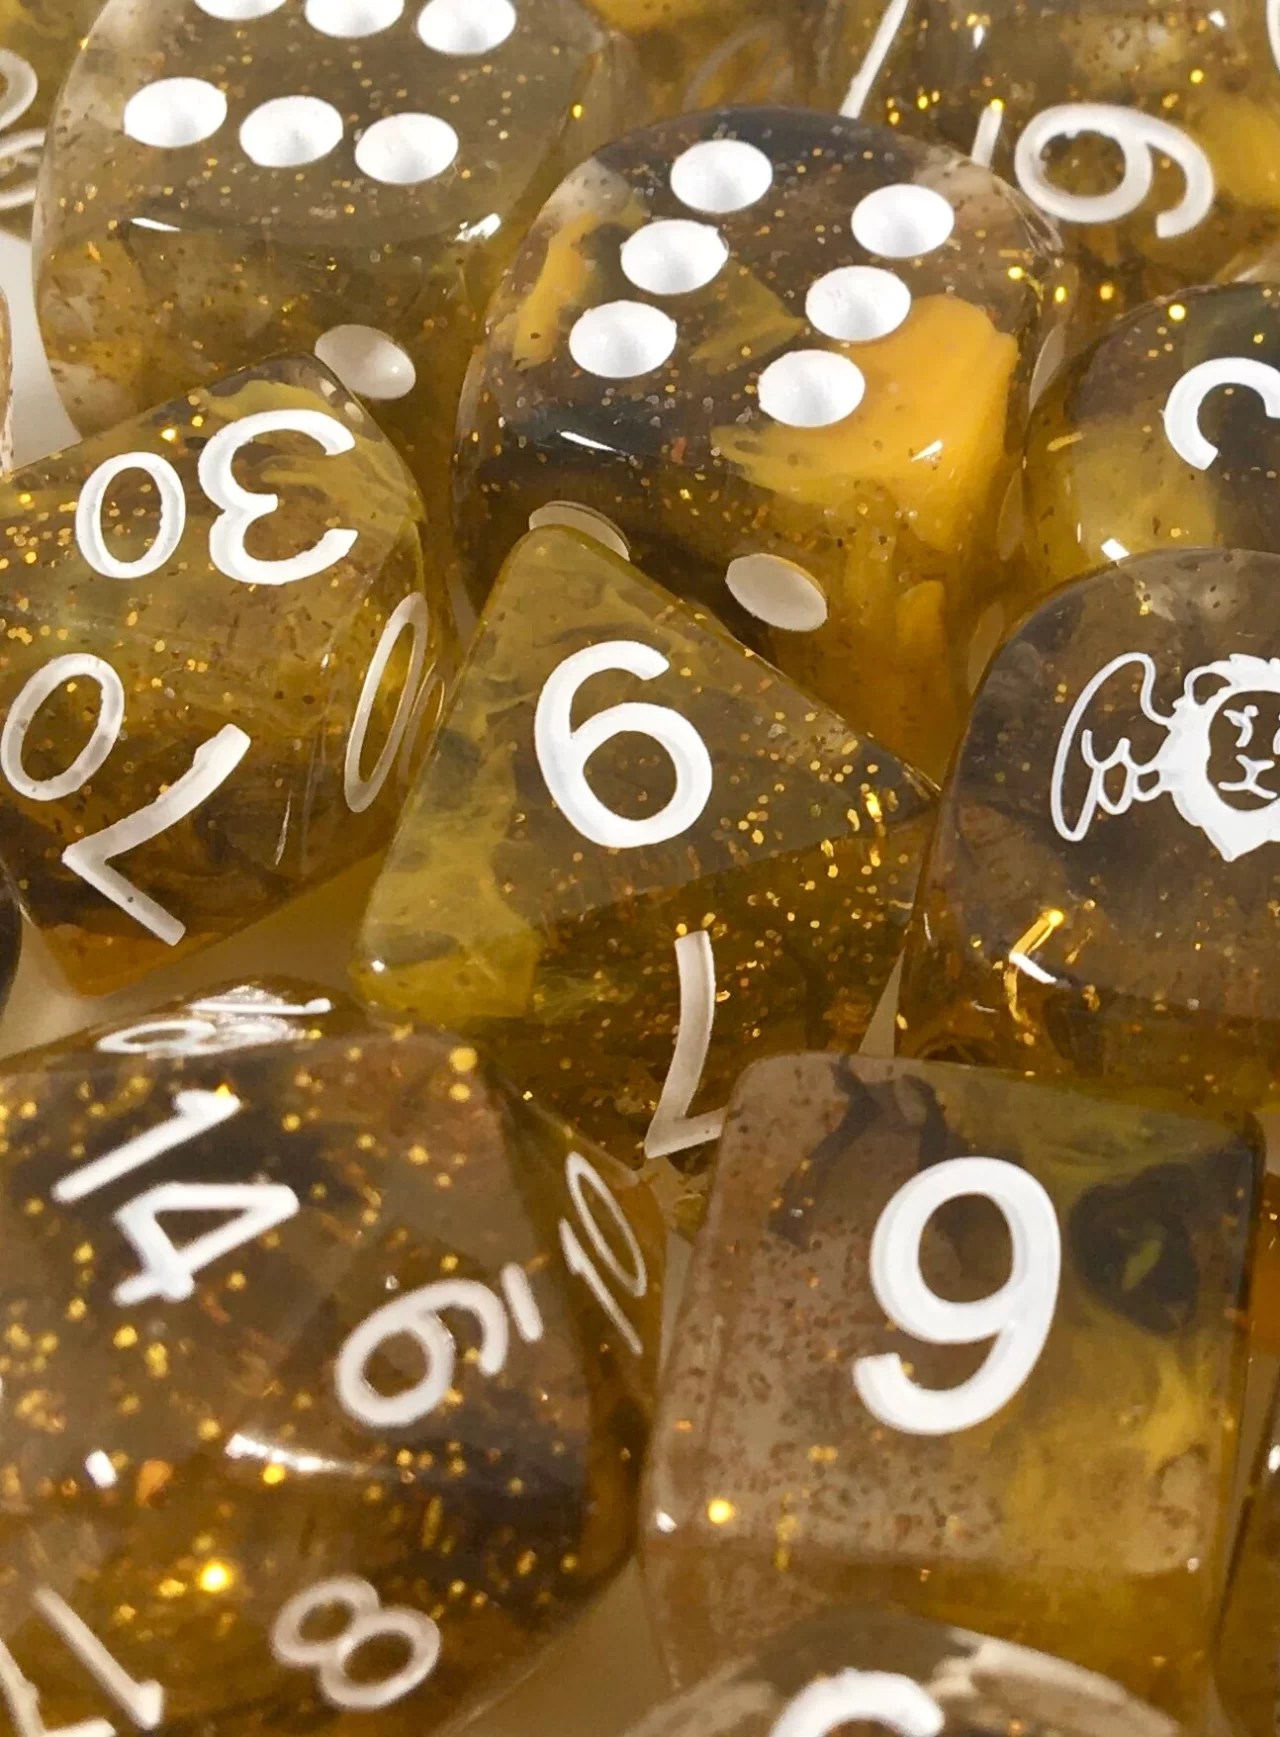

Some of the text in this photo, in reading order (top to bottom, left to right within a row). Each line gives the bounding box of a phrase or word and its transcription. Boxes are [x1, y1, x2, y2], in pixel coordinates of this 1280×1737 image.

[75, 408, 359, 586] 30
[534, 639, 713, 849] 6
[50, 1088, 300, 1306] 14
[269, 1574, 441, 1711] 8
